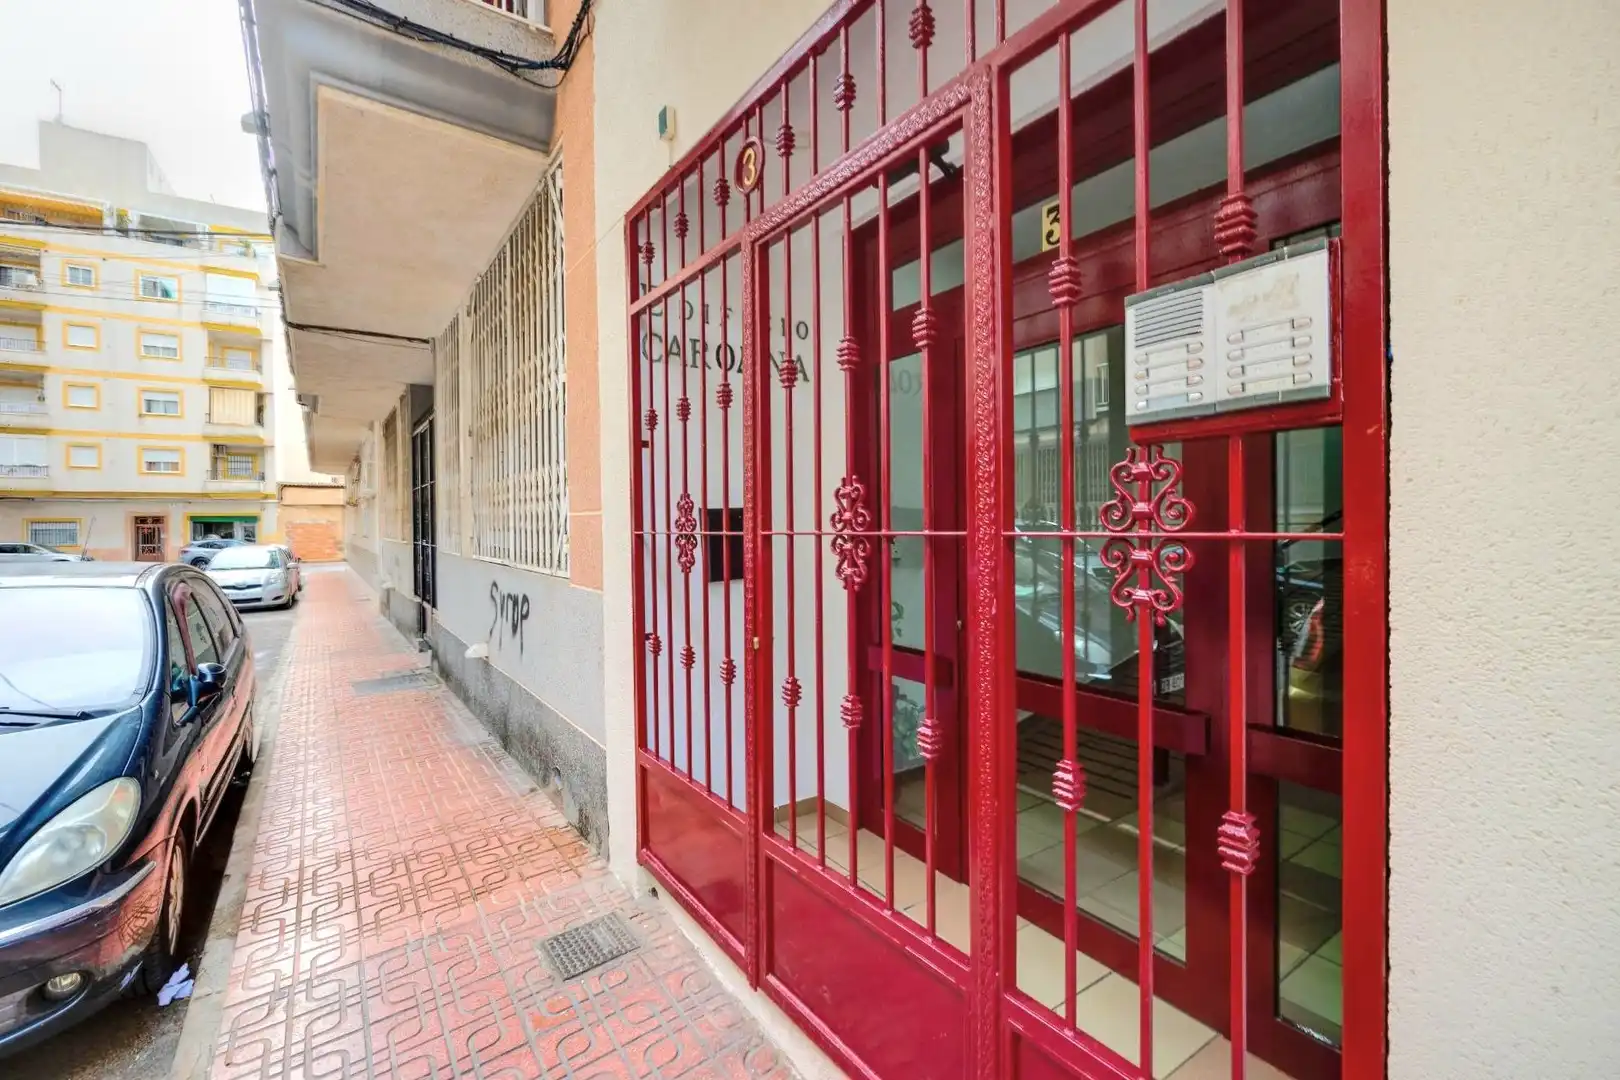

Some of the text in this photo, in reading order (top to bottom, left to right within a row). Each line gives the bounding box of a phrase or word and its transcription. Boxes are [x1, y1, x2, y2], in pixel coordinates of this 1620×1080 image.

[743, 147, 757, 186] 3
[1045, 203, 1061, 246] 3
[640, 282, 809, 340] EDIFIO
[641, 332, 810, 382] CARONA
